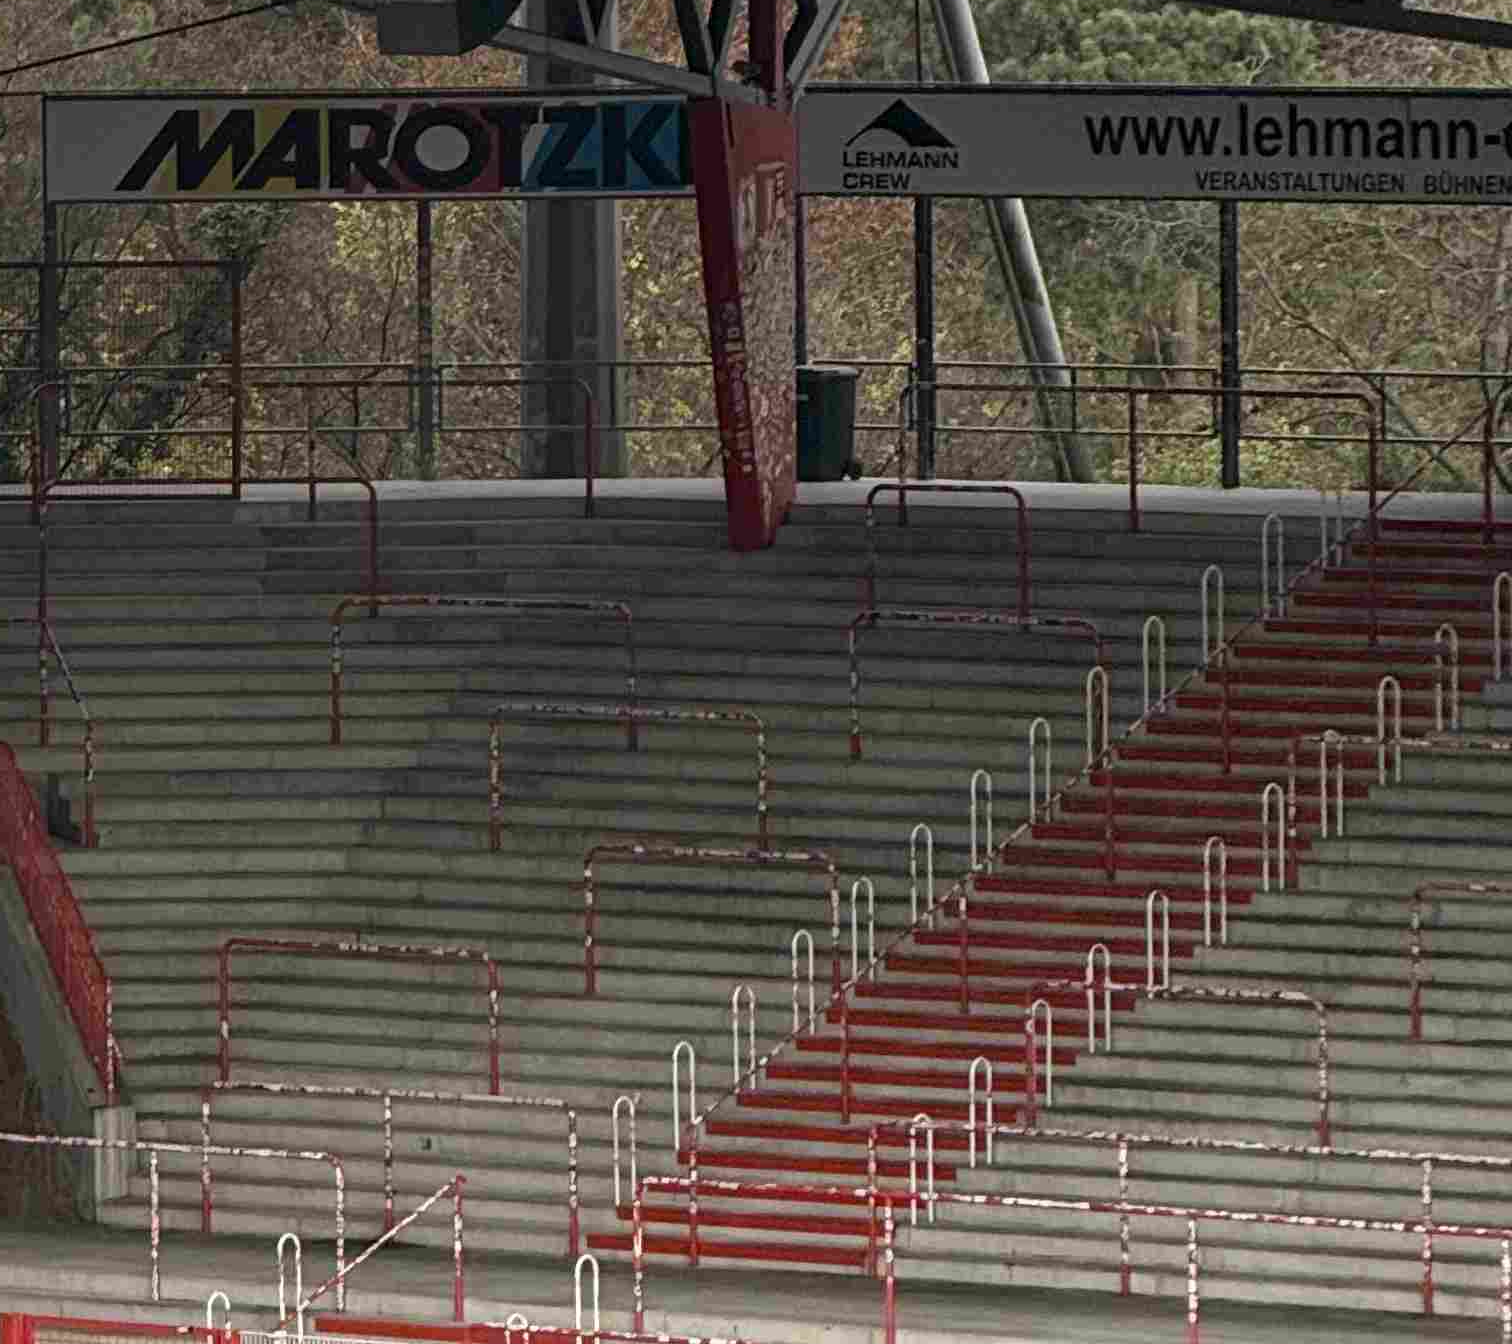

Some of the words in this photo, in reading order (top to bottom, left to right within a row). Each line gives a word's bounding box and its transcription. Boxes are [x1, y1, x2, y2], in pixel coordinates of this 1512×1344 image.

[1084, 103, 1512, 159] www.lehmann-
[114, 106, 695, 191] MAROTZK
[842, 151, 959, 169] LEHMANN
[842, 172, 910, 190] CREW
[1195, 171, 1405, 194] VERANSTALTUNGEN
